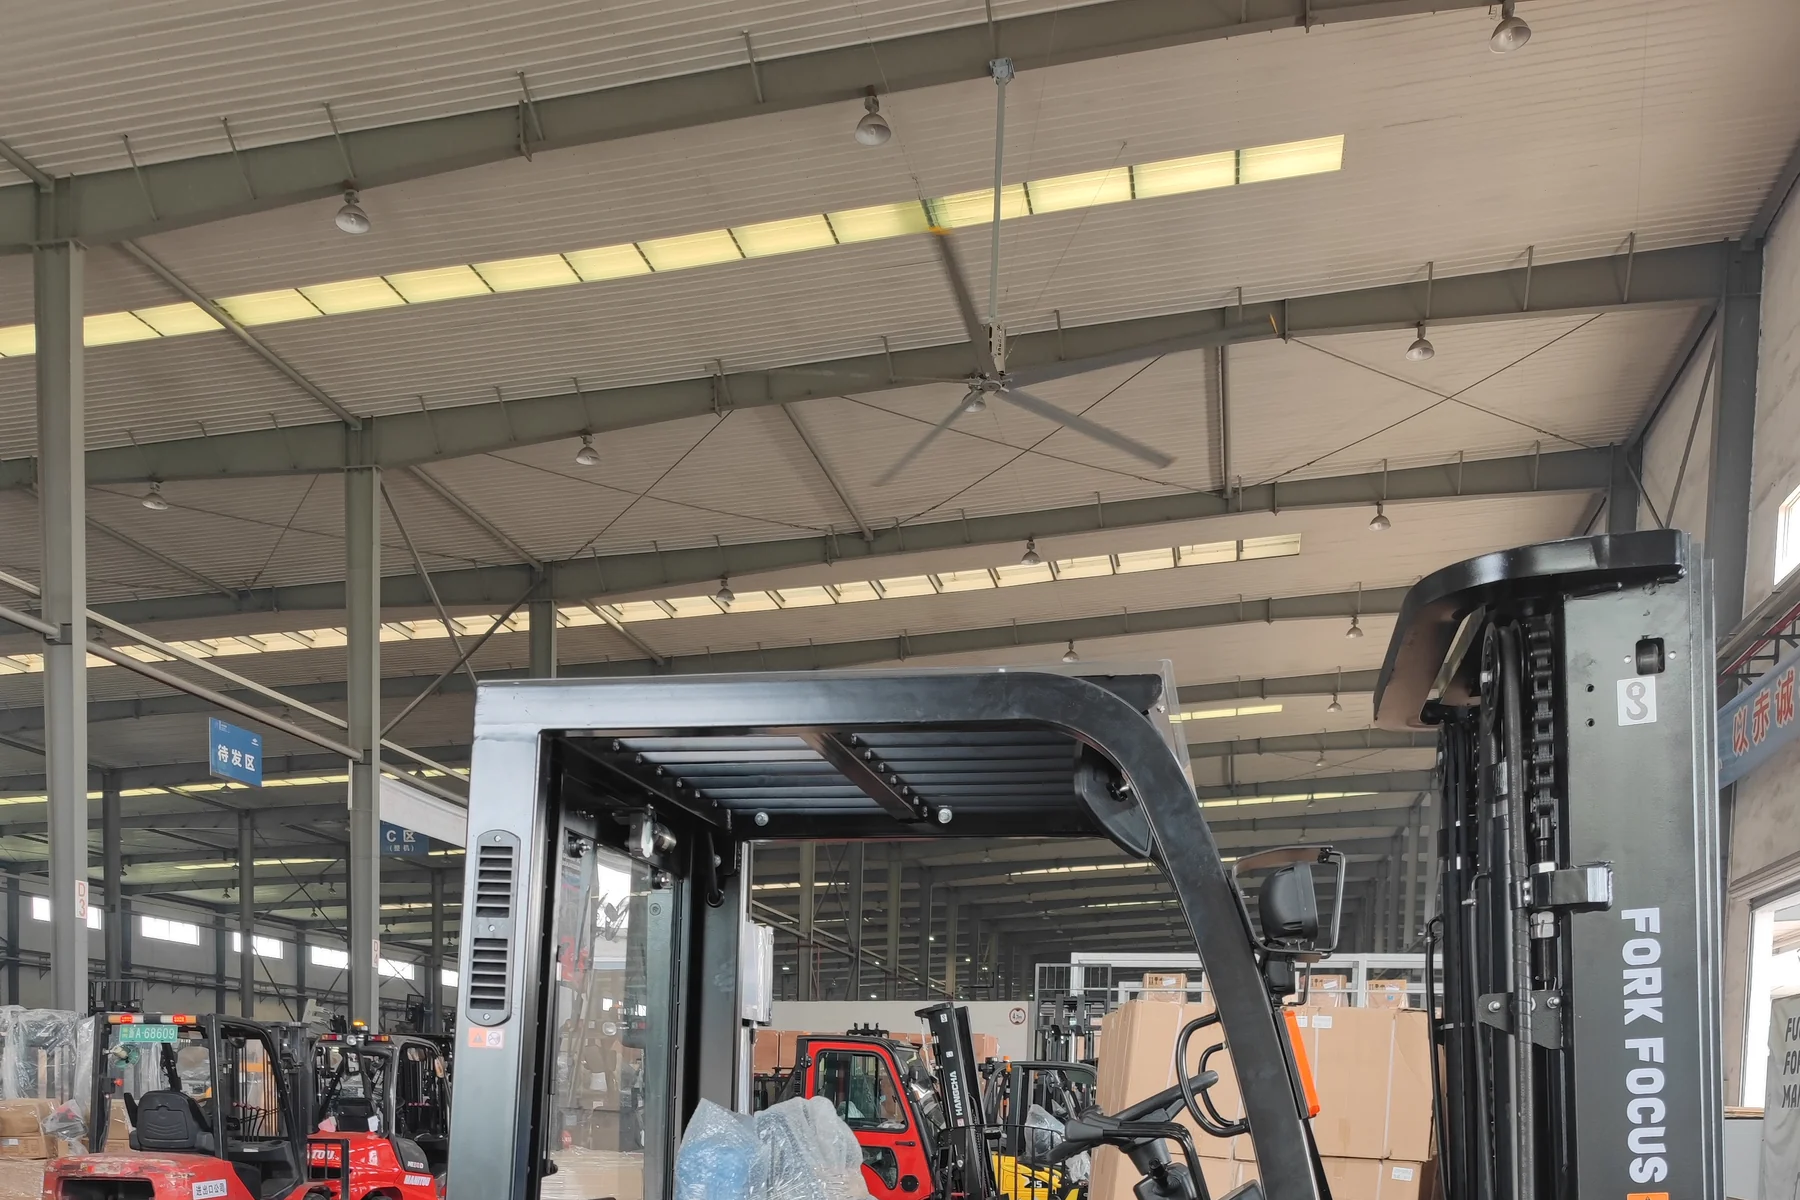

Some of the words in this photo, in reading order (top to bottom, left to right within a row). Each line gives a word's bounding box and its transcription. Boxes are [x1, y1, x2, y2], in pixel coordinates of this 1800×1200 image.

[217, 743, 256, 772] 待发区
[386, 829, 397, 842] C
[402, 829, 416, 843] 区
[78, 882, 86, 917] D3
[1620, 906, 1664, 1026] FORK
[949, 1070, 963, 1116] HANGCHA
[1624, 1036, 1669, 1184] FOCUS
